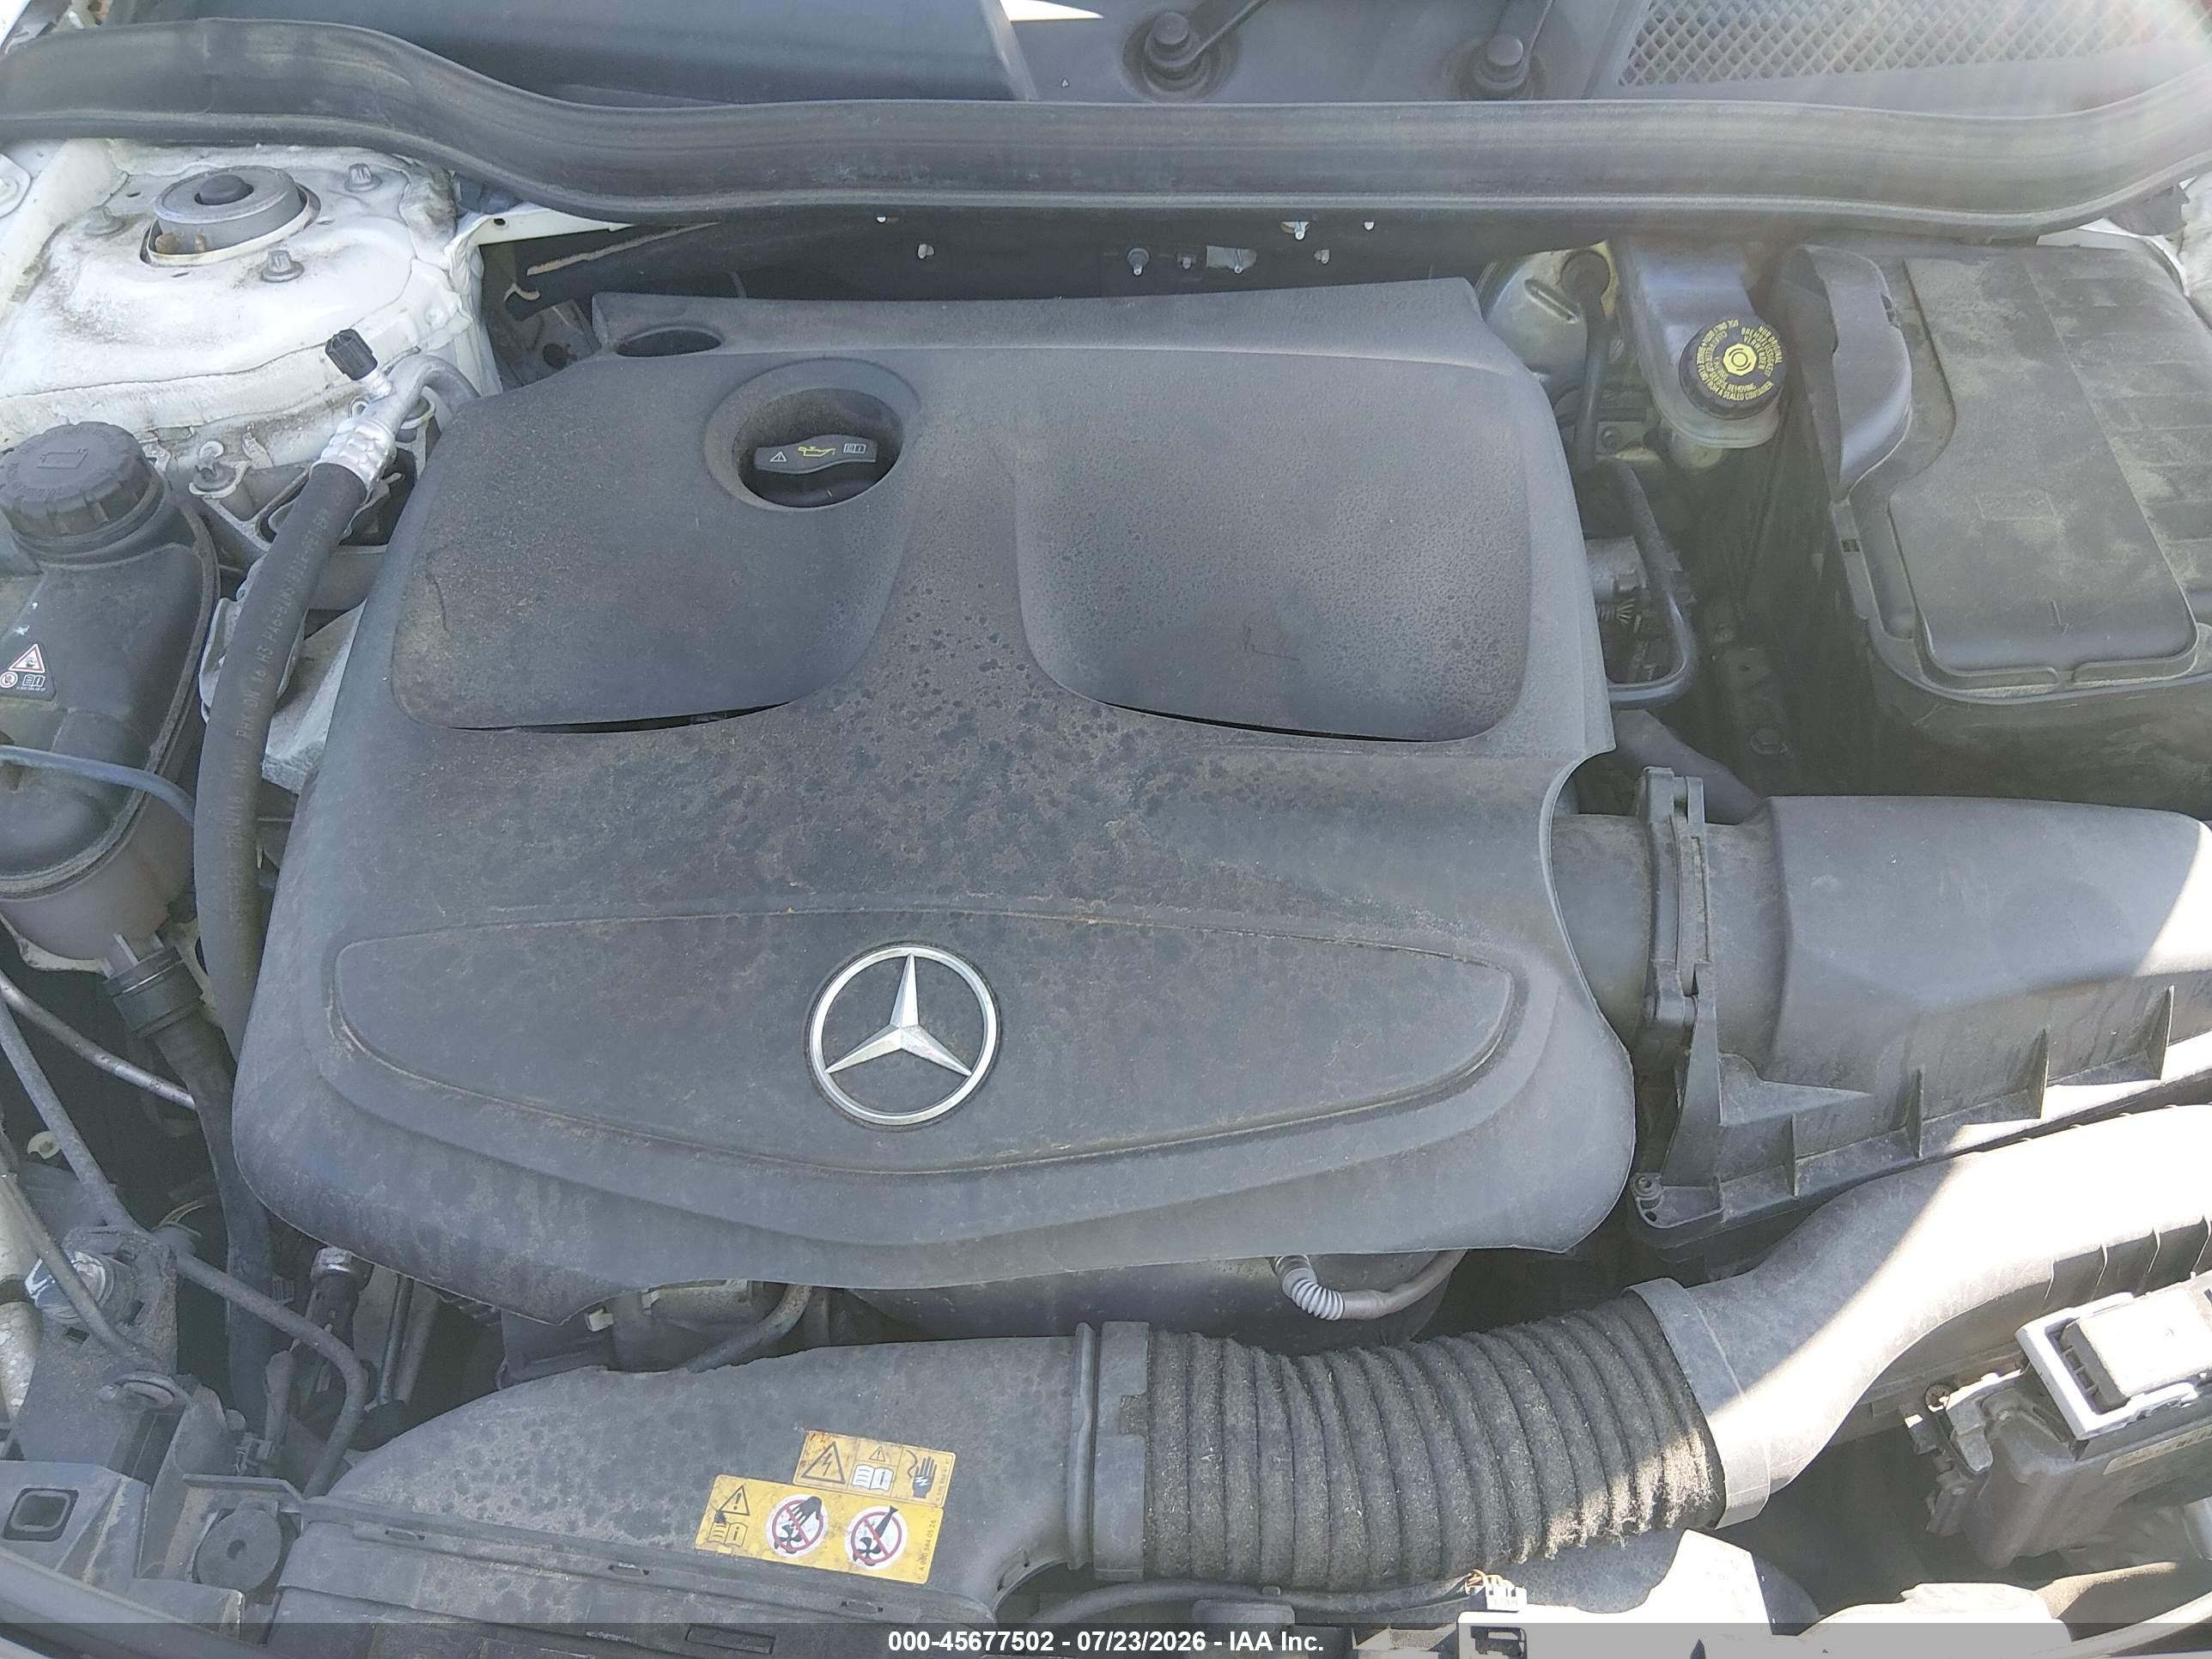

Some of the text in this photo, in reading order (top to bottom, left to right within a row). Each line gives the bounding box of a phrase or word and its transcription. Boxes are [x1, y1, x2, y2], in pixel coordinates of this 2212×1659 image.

[1758, 325, 1782, 364] NUR ORIGINAL
[1723, 391, 1745, 401] SEALED
